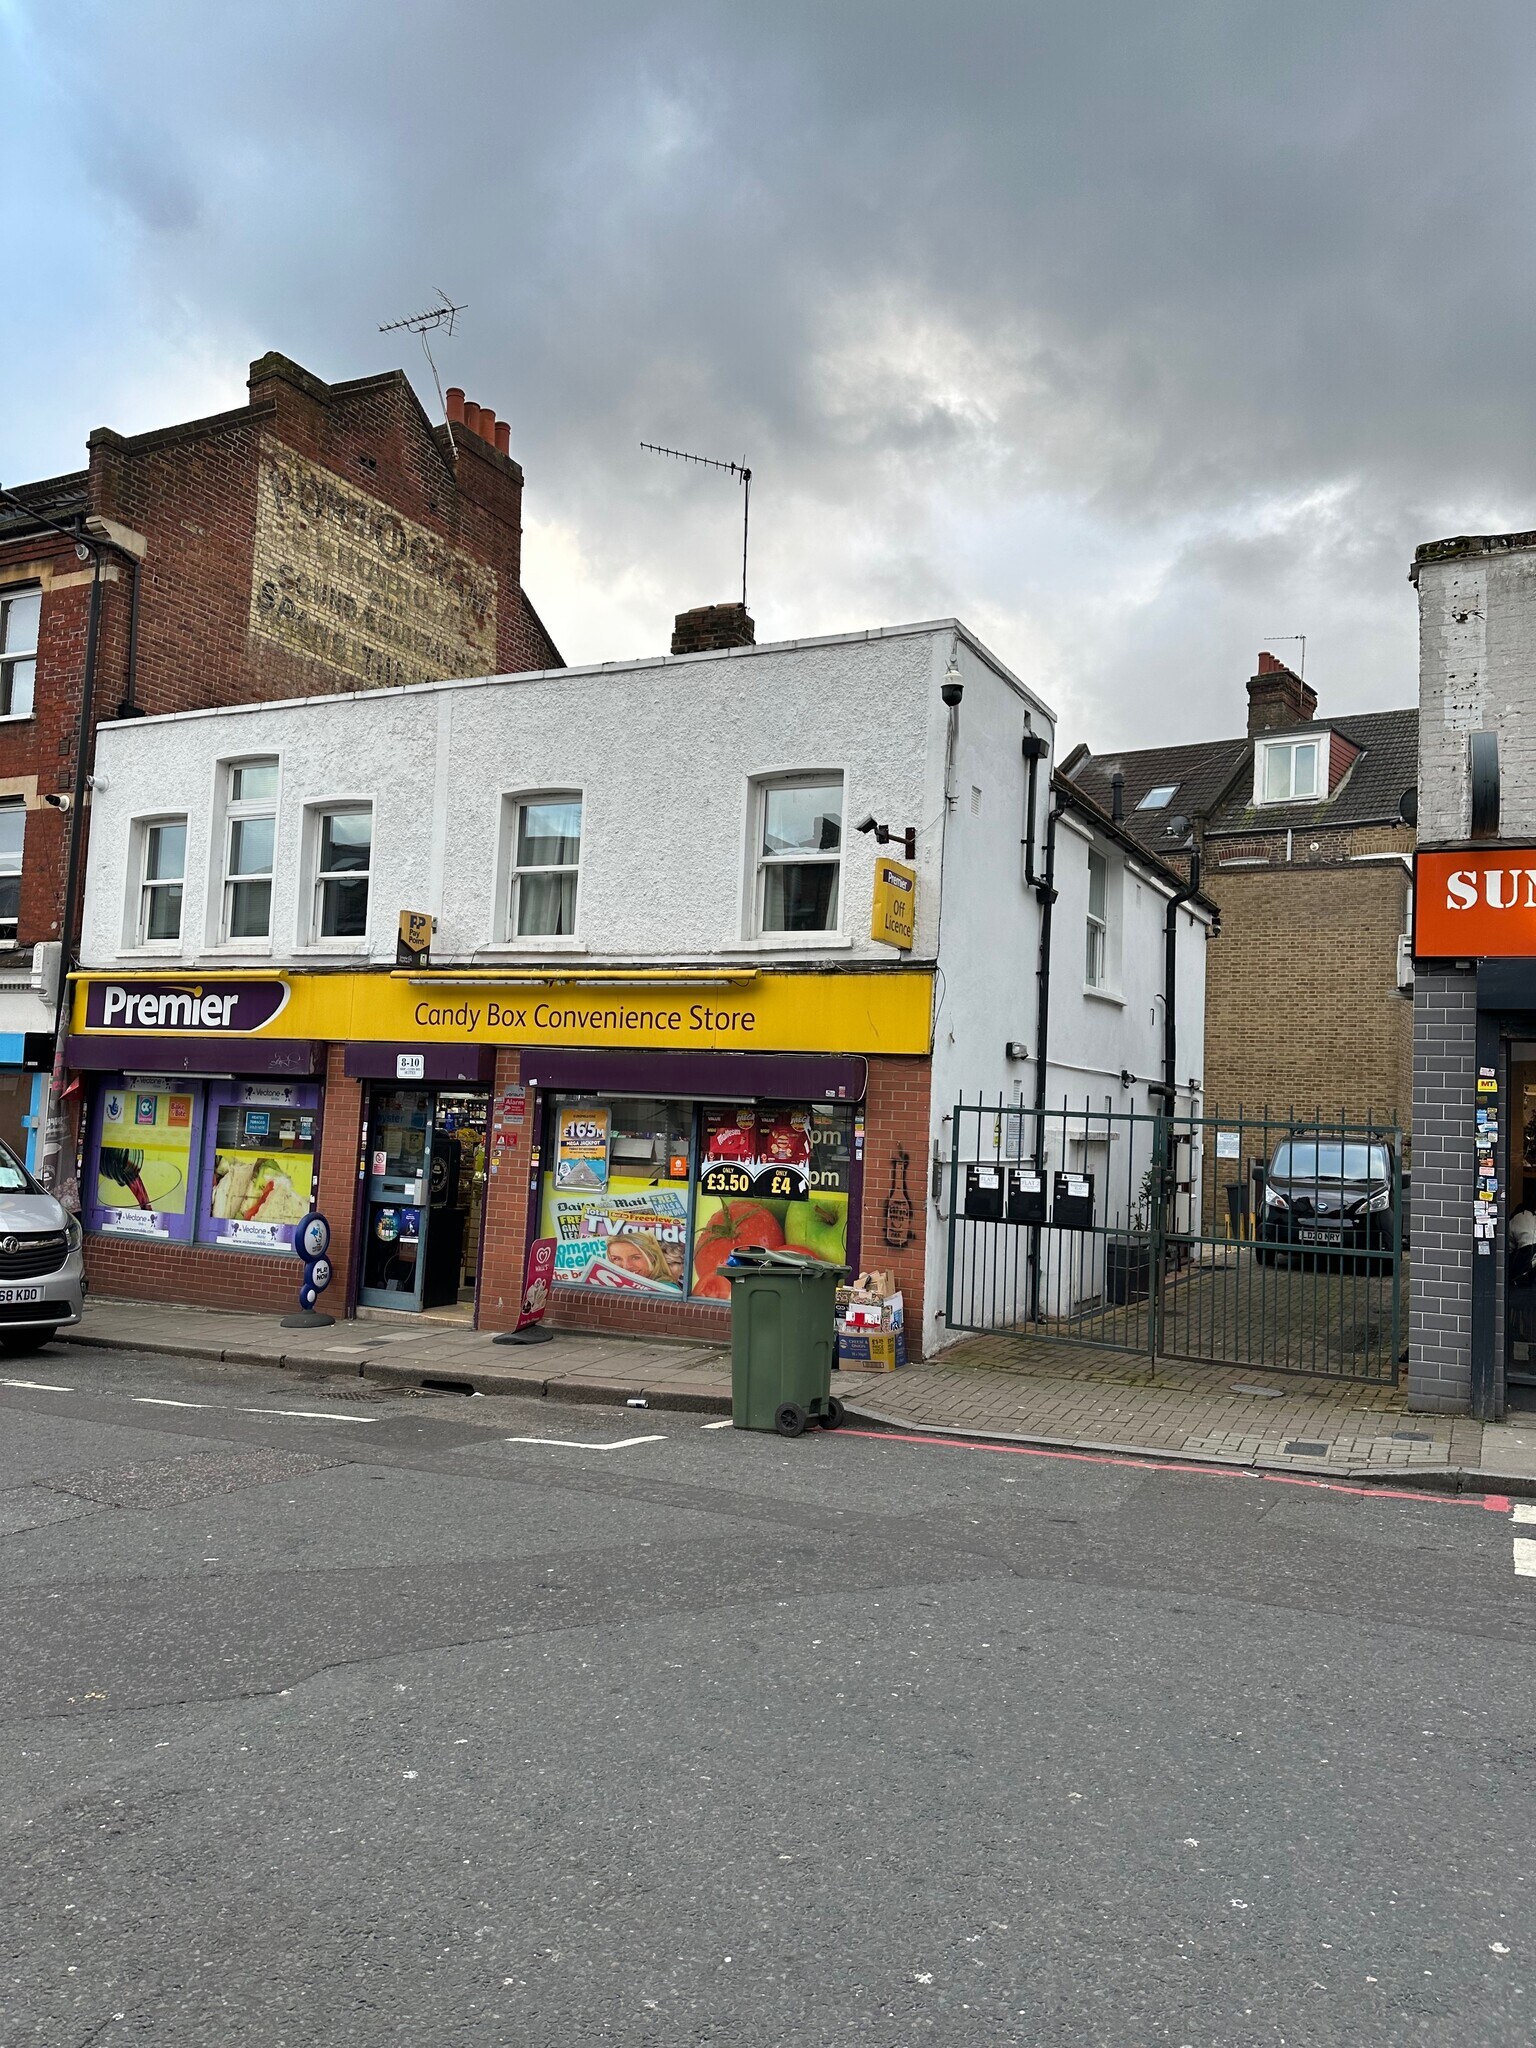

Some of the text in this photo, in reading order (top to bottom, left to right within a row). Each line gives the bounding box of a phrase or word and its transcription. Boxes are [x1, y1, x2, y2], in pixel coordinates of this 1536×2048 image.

[888, 871, 908, 890] Premier
[893, 899, 906, 917] Off
[885, 913, 911, 937] Licence
[409, 929, 420, 939] Pay
[408, 936, 425, 945] Point
[103, 986, 239, 1027] Premier
[415, 1002, 756, 1032] Candy Box Convenience Store
[401, 1057, 420, 1068] 8-10
[256, 1088, 281, 1097] Vectone
[811, 1130, 842, 1149] pm
[775, 1169, 788, 1177] ONLY
[707, 1174, 749, 1191] £3.50
[771, 1177, 791, 1194] £4
[809, 1170, 840, 1190] pm
[613, 1197, 648, 1208] Mail
[651, 1193, 677, 1205] FREE
[125, 1213, 147, 1222] Vectone
[585, 1207, 608, 1217] Total
[559, 1216, 581, 1225] FRE
[630, 1214, 672, 1223] Freeview
[242, 1226, 267, 1235] Vectone
[562, 1224, 580, 1232] GIA
[557, 1239, 607, 1255] oman's
[16, 1289, 37, 1301] KDO
